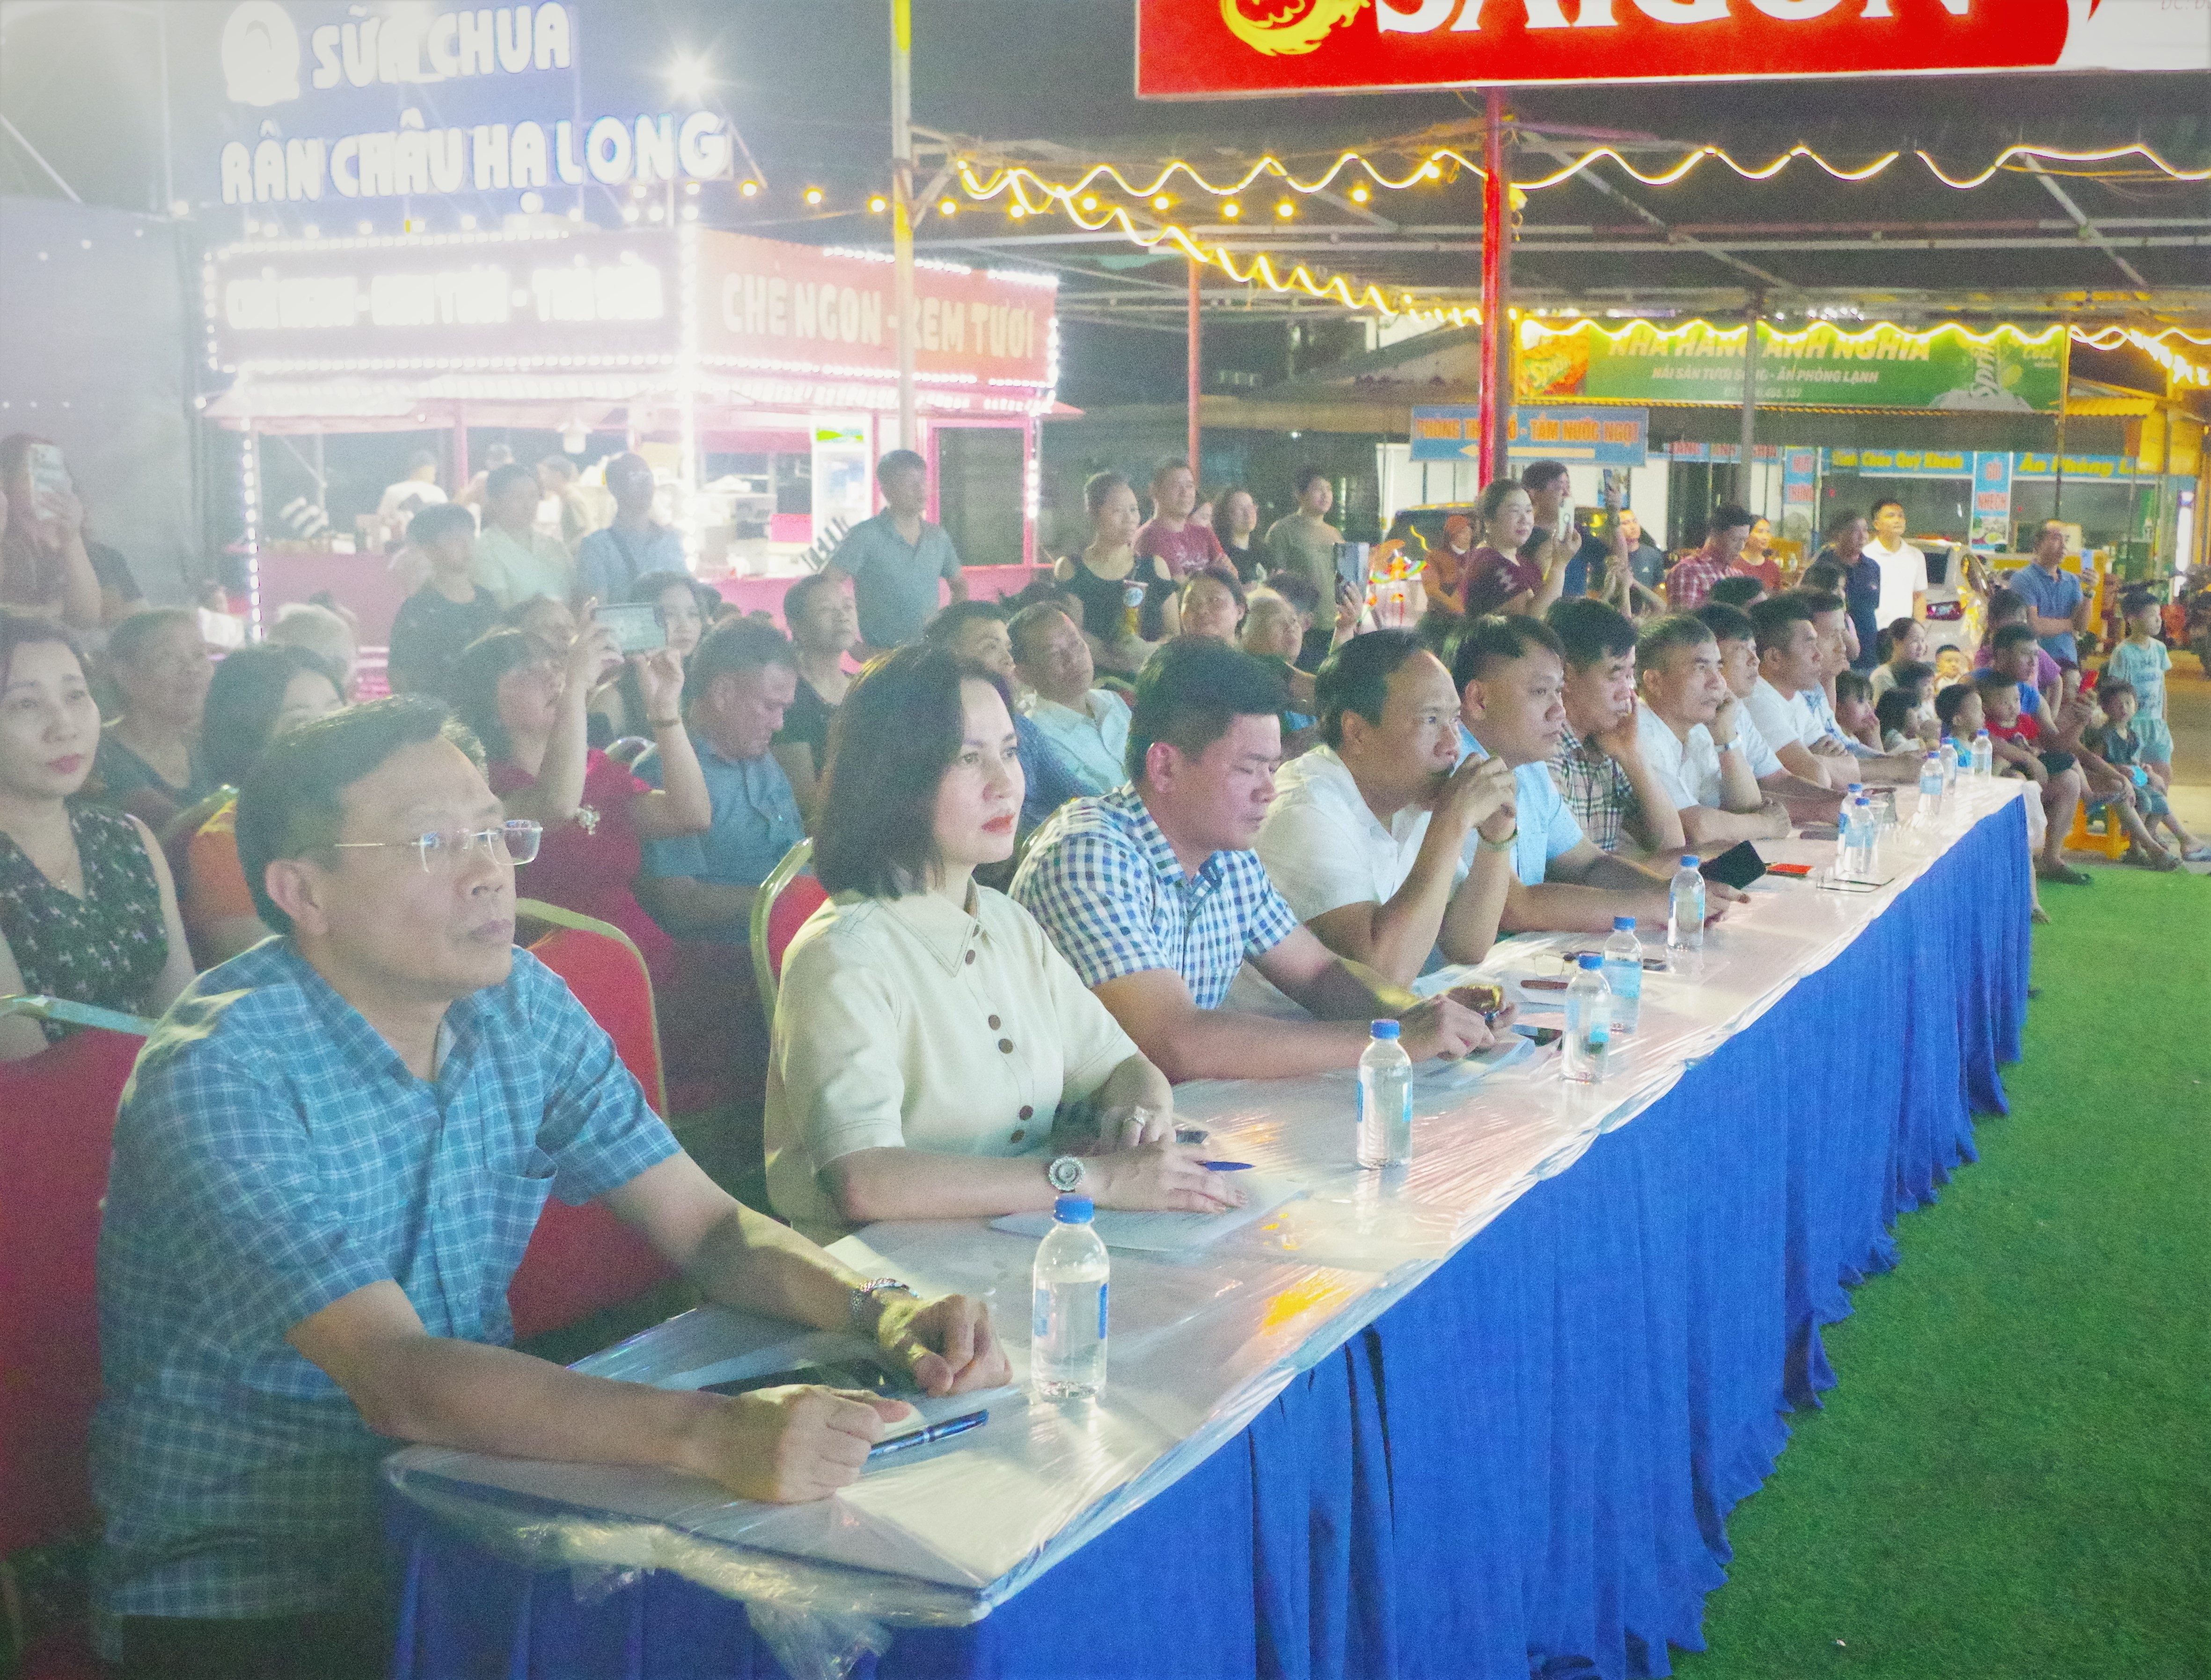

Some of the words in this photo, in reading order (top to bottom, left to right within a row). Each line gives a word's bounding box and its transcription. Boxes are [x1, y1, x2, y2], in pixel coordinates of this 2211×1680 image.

[427, 1, 571, 77] CHUA
[330, 107, 464, 197] CHÂU
[556, 111, 727, 185] LONG
[795, 281, 882, 346] NGON
